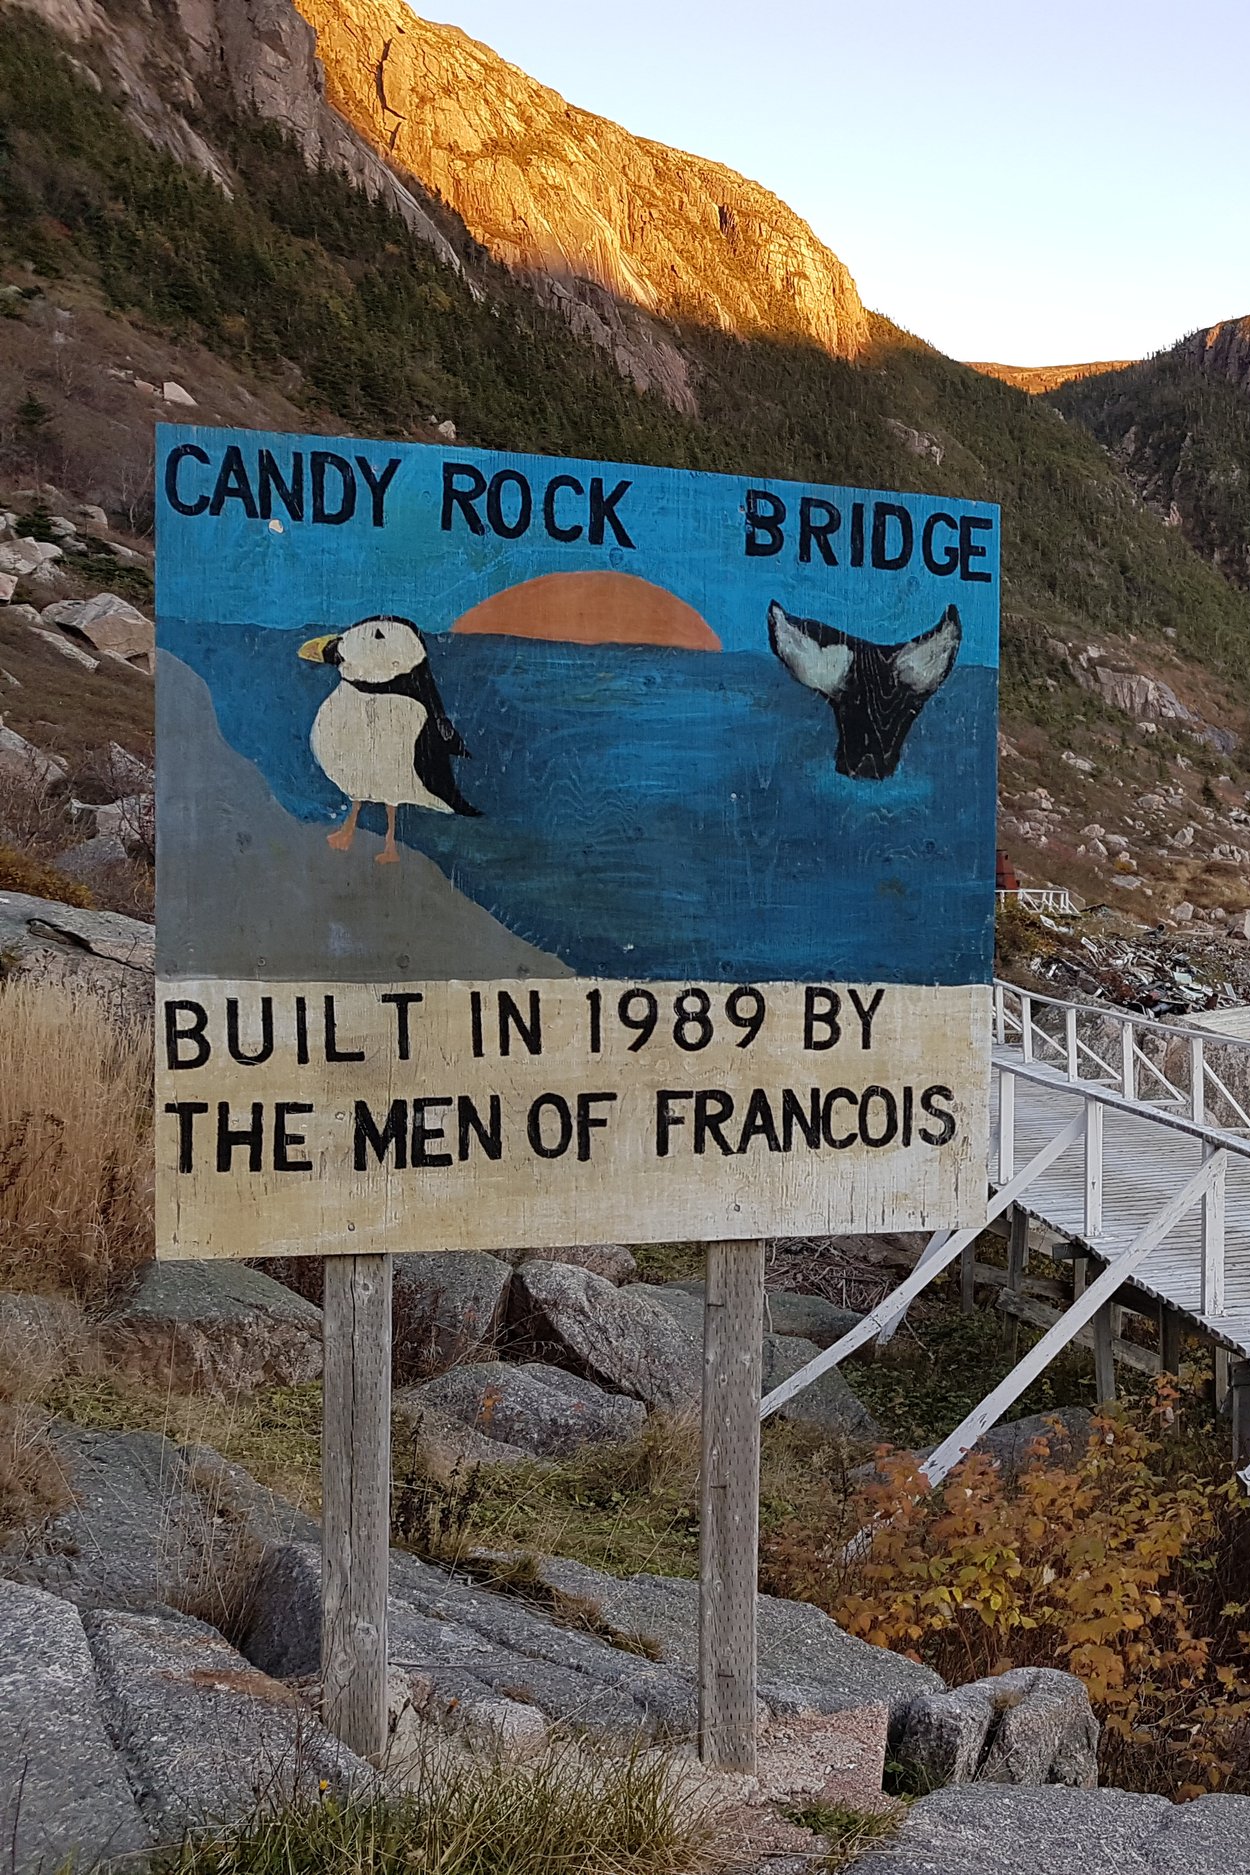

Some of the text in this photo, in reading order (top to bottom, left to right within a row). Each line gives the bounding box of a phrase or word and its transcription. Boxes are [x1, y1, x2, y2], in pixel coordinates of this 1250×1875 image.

[165, 444, 994, 582] CANDY ROCK BRIDGE
[164, 986, 885, 1070] BUILT IN 1989 BY
[164, 1083, 957, 1173] THE MEN OF FRANCOIS
